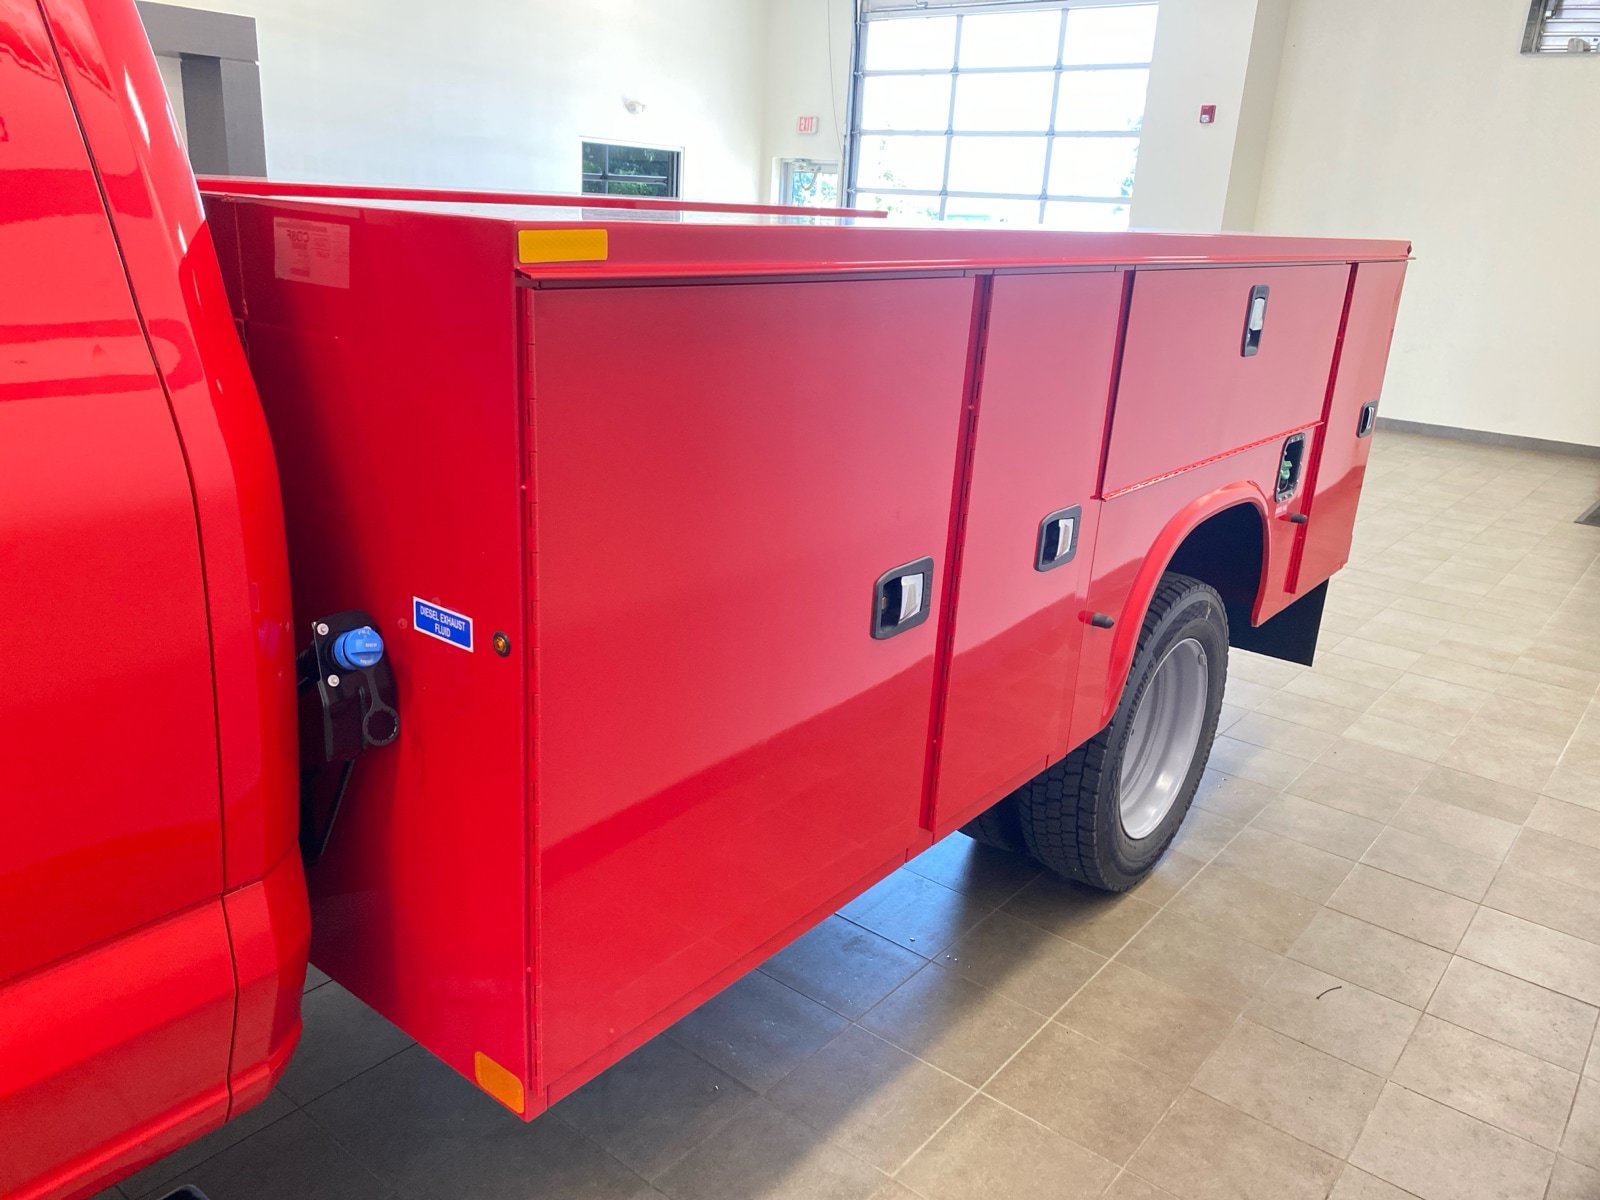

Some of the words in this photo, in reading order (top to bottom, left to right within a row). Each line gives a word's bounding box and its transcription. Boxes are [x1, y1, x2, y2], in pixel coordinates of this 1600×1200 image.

[799, 116, 813, 131] EXIT
[420, 605, 439, 621] DIESEL
[440, 613, 466, 631] EXHAUST
[434, 623, 451, 637] FLUID
